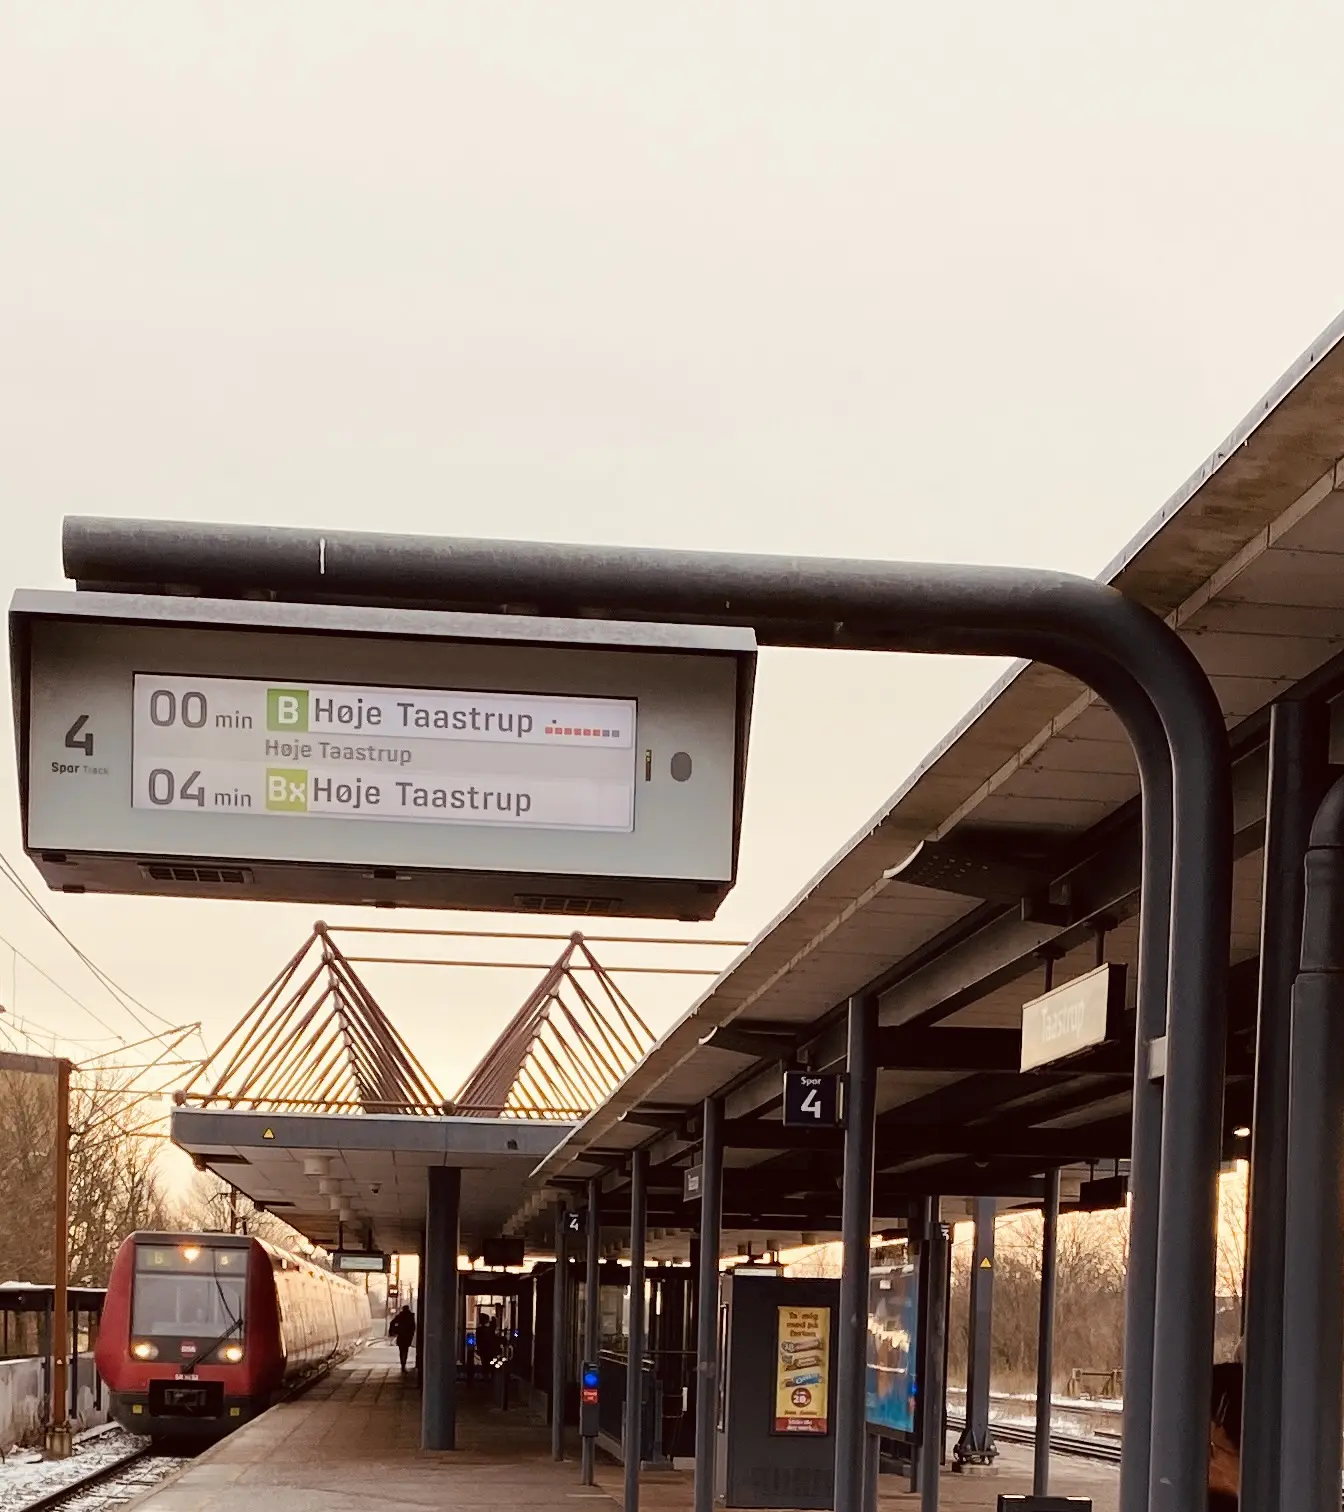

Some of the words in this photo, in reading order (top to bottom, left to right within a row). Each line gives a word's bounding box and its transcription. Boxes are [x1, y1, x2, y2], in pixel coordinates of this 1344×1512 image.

[149, 689, 208, 729] 00
[215, 710, 253, 730] min
[277, 695, 299, 725] B
[313, 698, 383, 730] Høje
[396, 702, 534, 738] Taastrup
[64, 714, 95, 757] 4
[264, 738, 313, 761] Høje
[318, 741, 413, 766] Taastrup
[51, 761, 81, 775] Spor
[148, 767, 206, 808] 04
[213, 788, 252, 807] min
[267, 775, 306, 804] Bx
[312, 777, 382, 809] Høje
[395, 781, 532, 817] Taastrup
[800, 1076, 822, 1087] Spor
[800, 1089, 822, 1119] 4
[569, 1218, 579, 1231] 4
